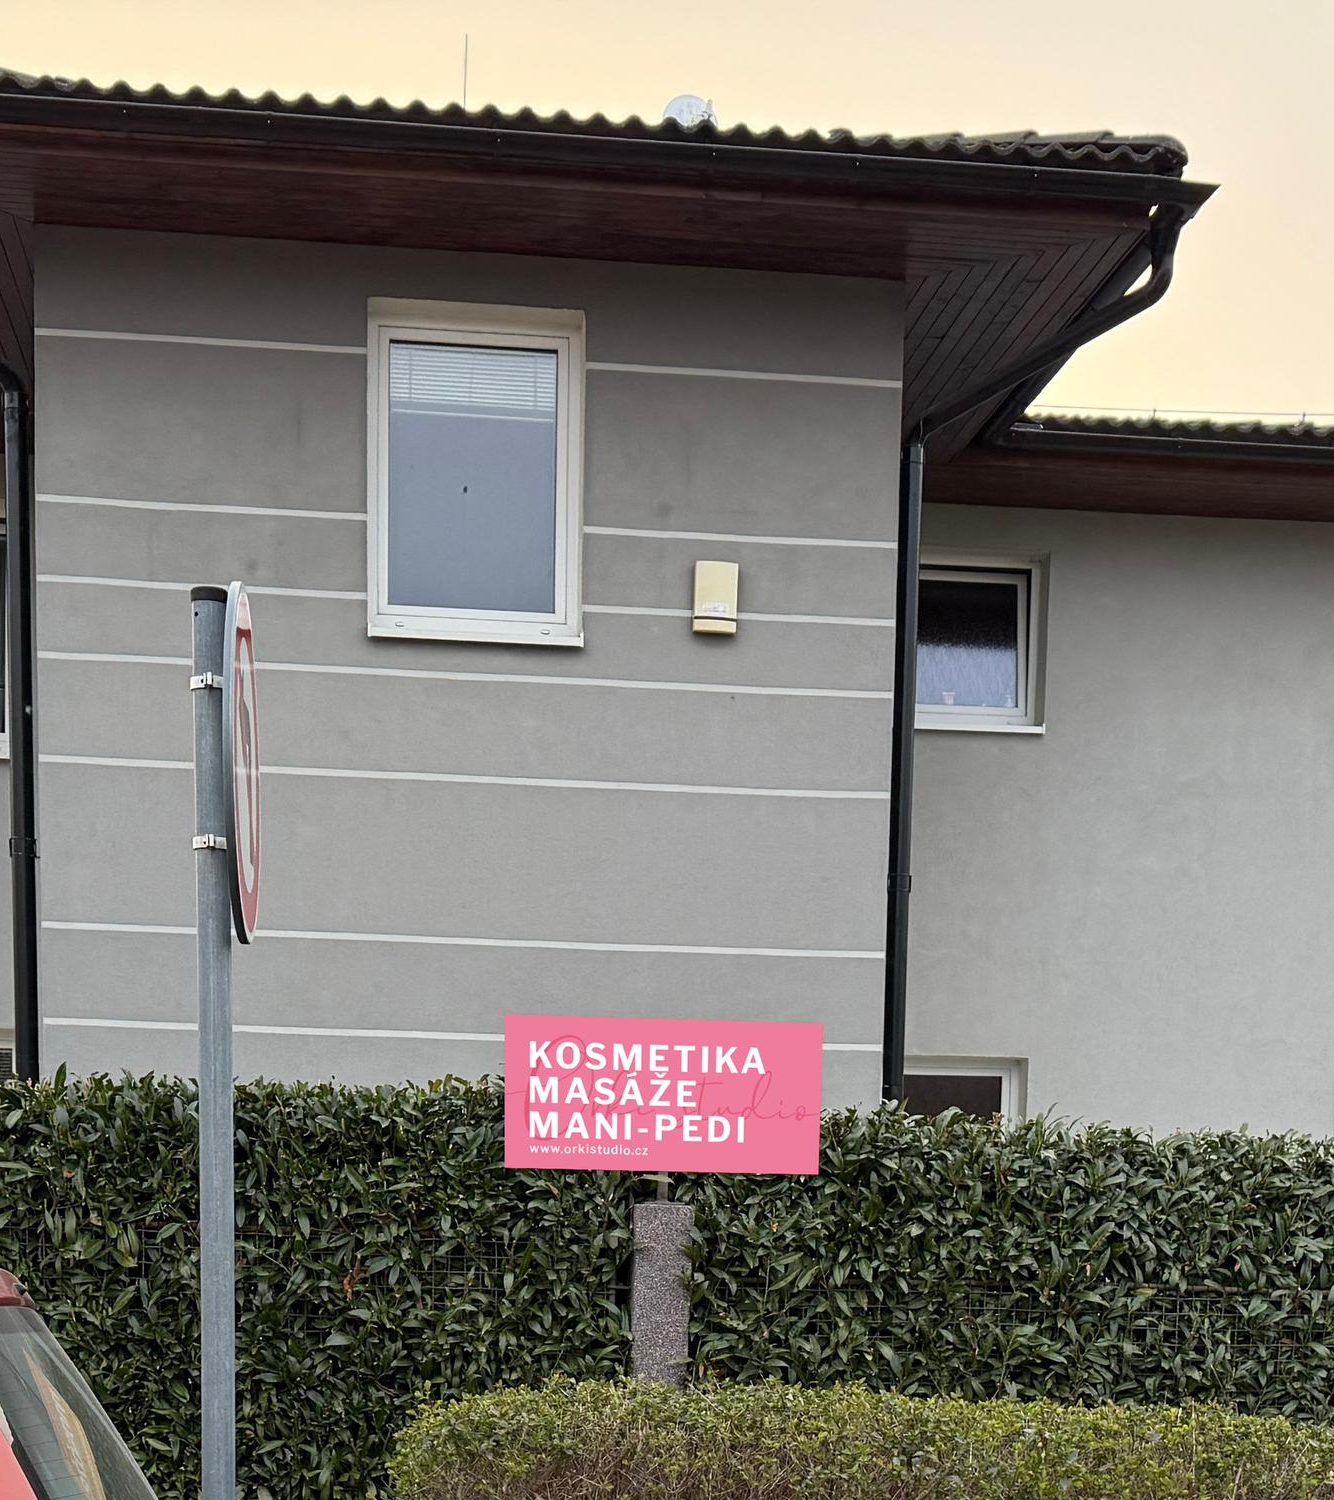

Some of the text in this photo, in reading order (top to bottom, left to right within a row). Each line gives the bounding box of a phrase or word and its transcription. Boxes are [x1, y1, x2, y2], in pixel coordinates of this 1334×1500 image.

[528, 1040, 766, 1075] KOSMETIKA
[528, 1071, 697, 1108] MASÁŽE
[528, 1110, 746, 1144] MANI-PEDI
[528, 1143, 649, 1157] www.orkistudio.cz
